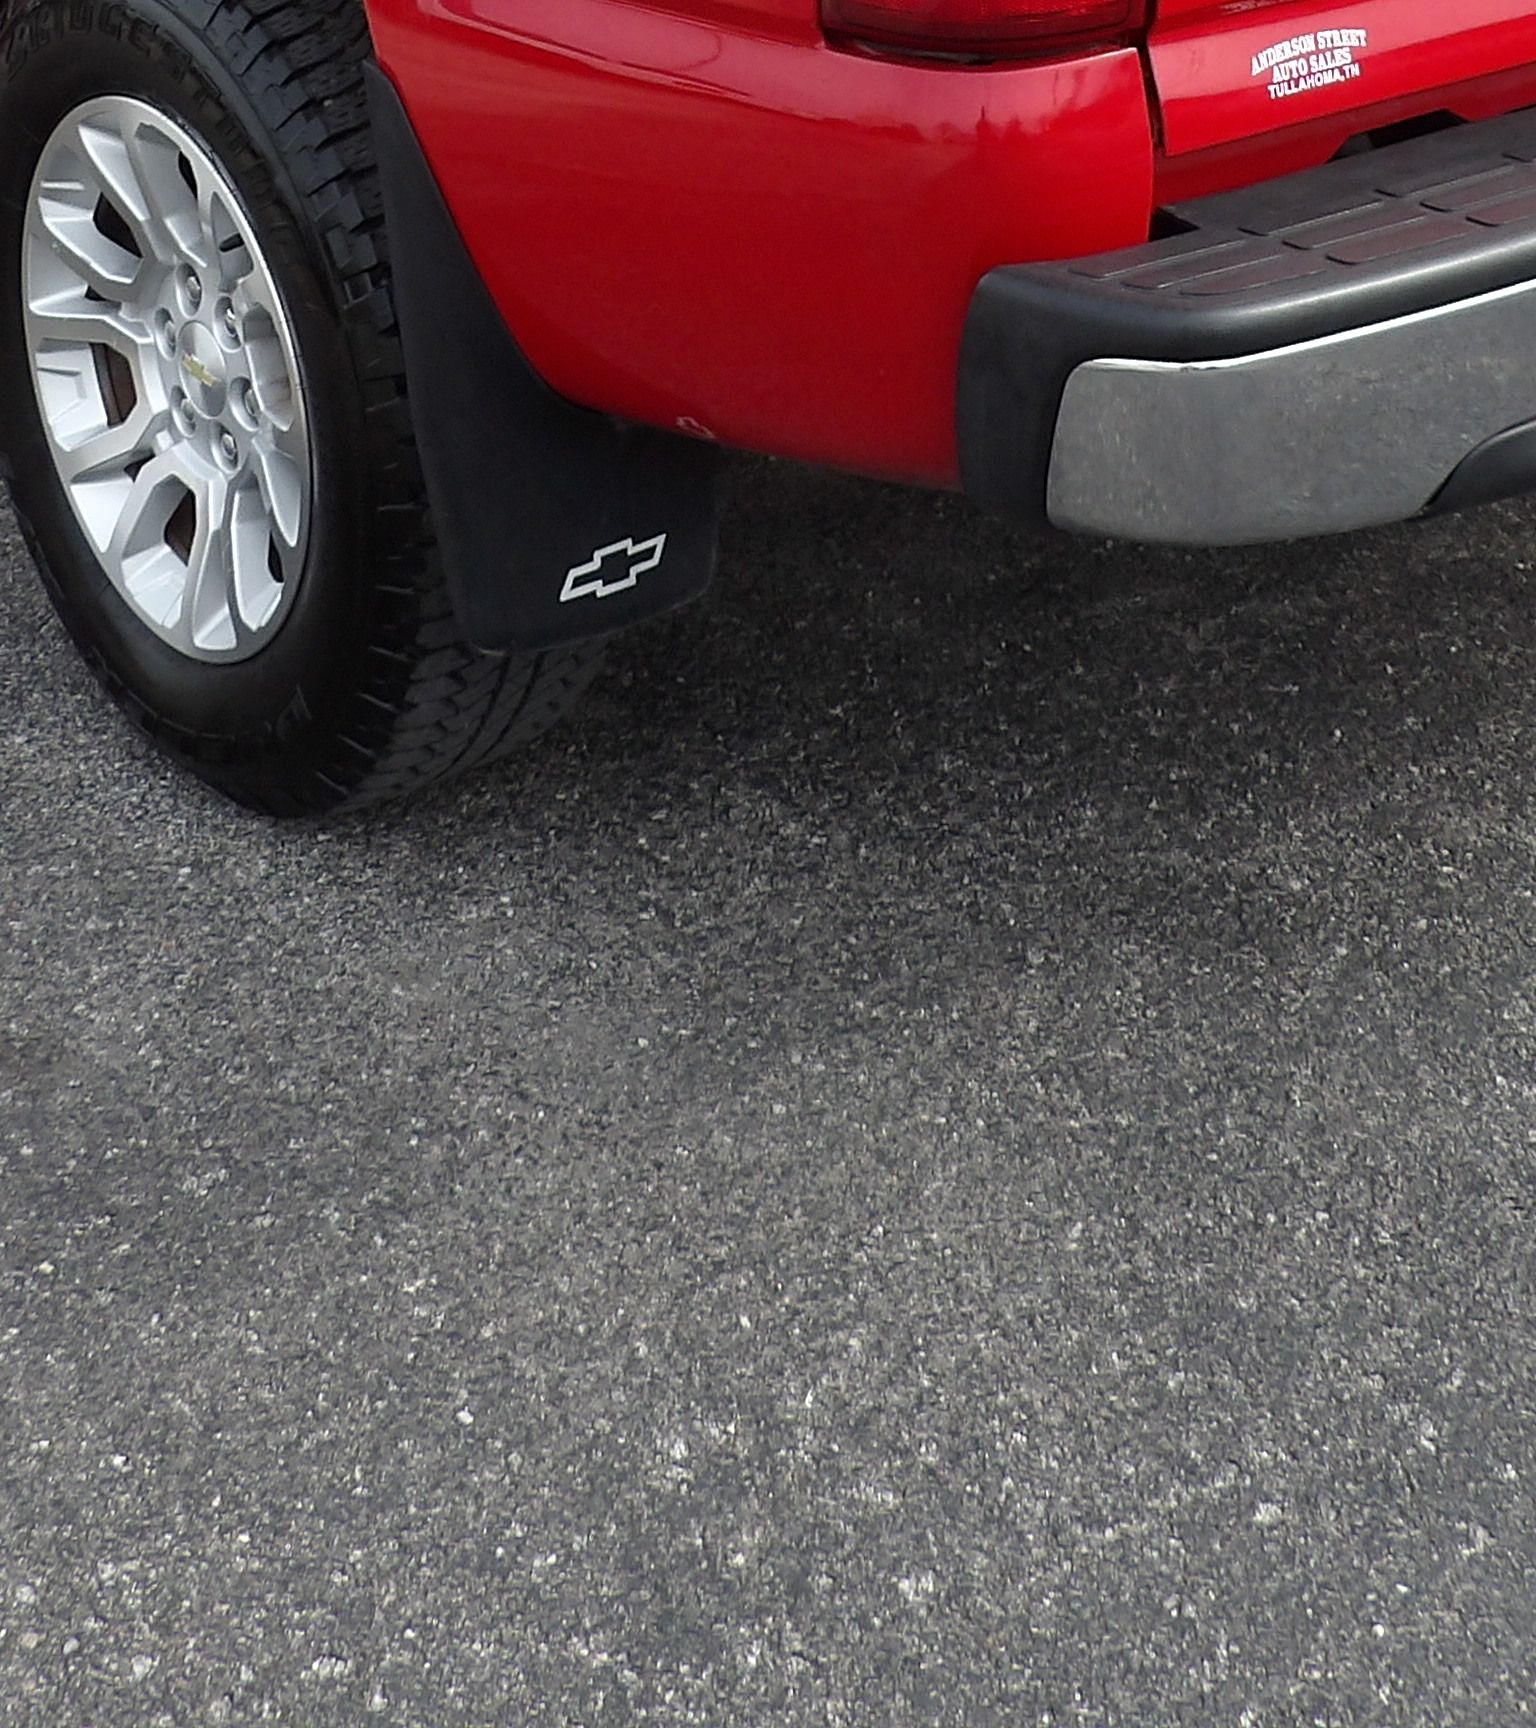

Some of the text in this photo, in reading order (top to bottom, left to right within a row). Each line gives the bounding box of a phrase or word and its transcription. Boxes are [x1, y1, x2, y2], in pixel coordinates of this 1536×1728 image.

[1251, 29, 1367, 76] ANDERSON STREET
[1272, 46, 1352, 83] AUTO SALES
